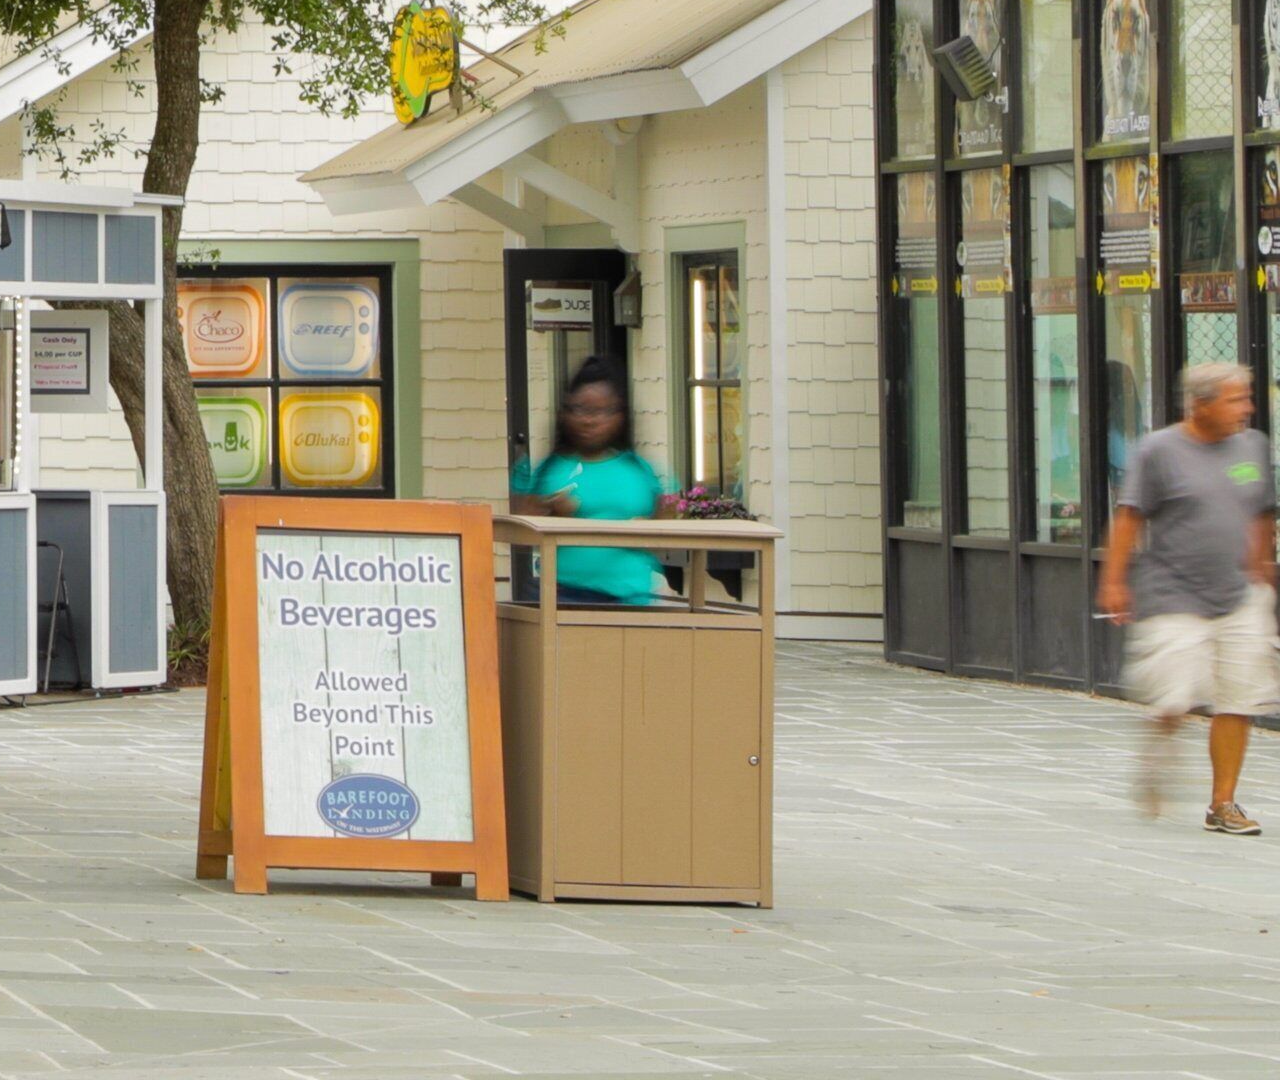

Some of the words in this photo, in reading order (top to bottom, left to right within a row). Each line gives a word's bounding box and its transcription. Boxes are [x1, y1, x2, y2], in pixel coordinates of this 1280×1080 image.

[198, 322, 240, 337] Chaco
[312, 324, 352, 338] REEF
[304, 432, 351, 447] OluKai
[262, 553, 304, 581] No
[312, 554, 452, 584] Alcoholic
[280, 598, 438, 636] Beverages
[315, 671, 409, 692] Allowed
[293, 703, 378, 728] Beyond
[384, 704, 434, 725] This
[335, 735, 396, 757] Point
[326, 790, 410, 807] BAREFOOT
